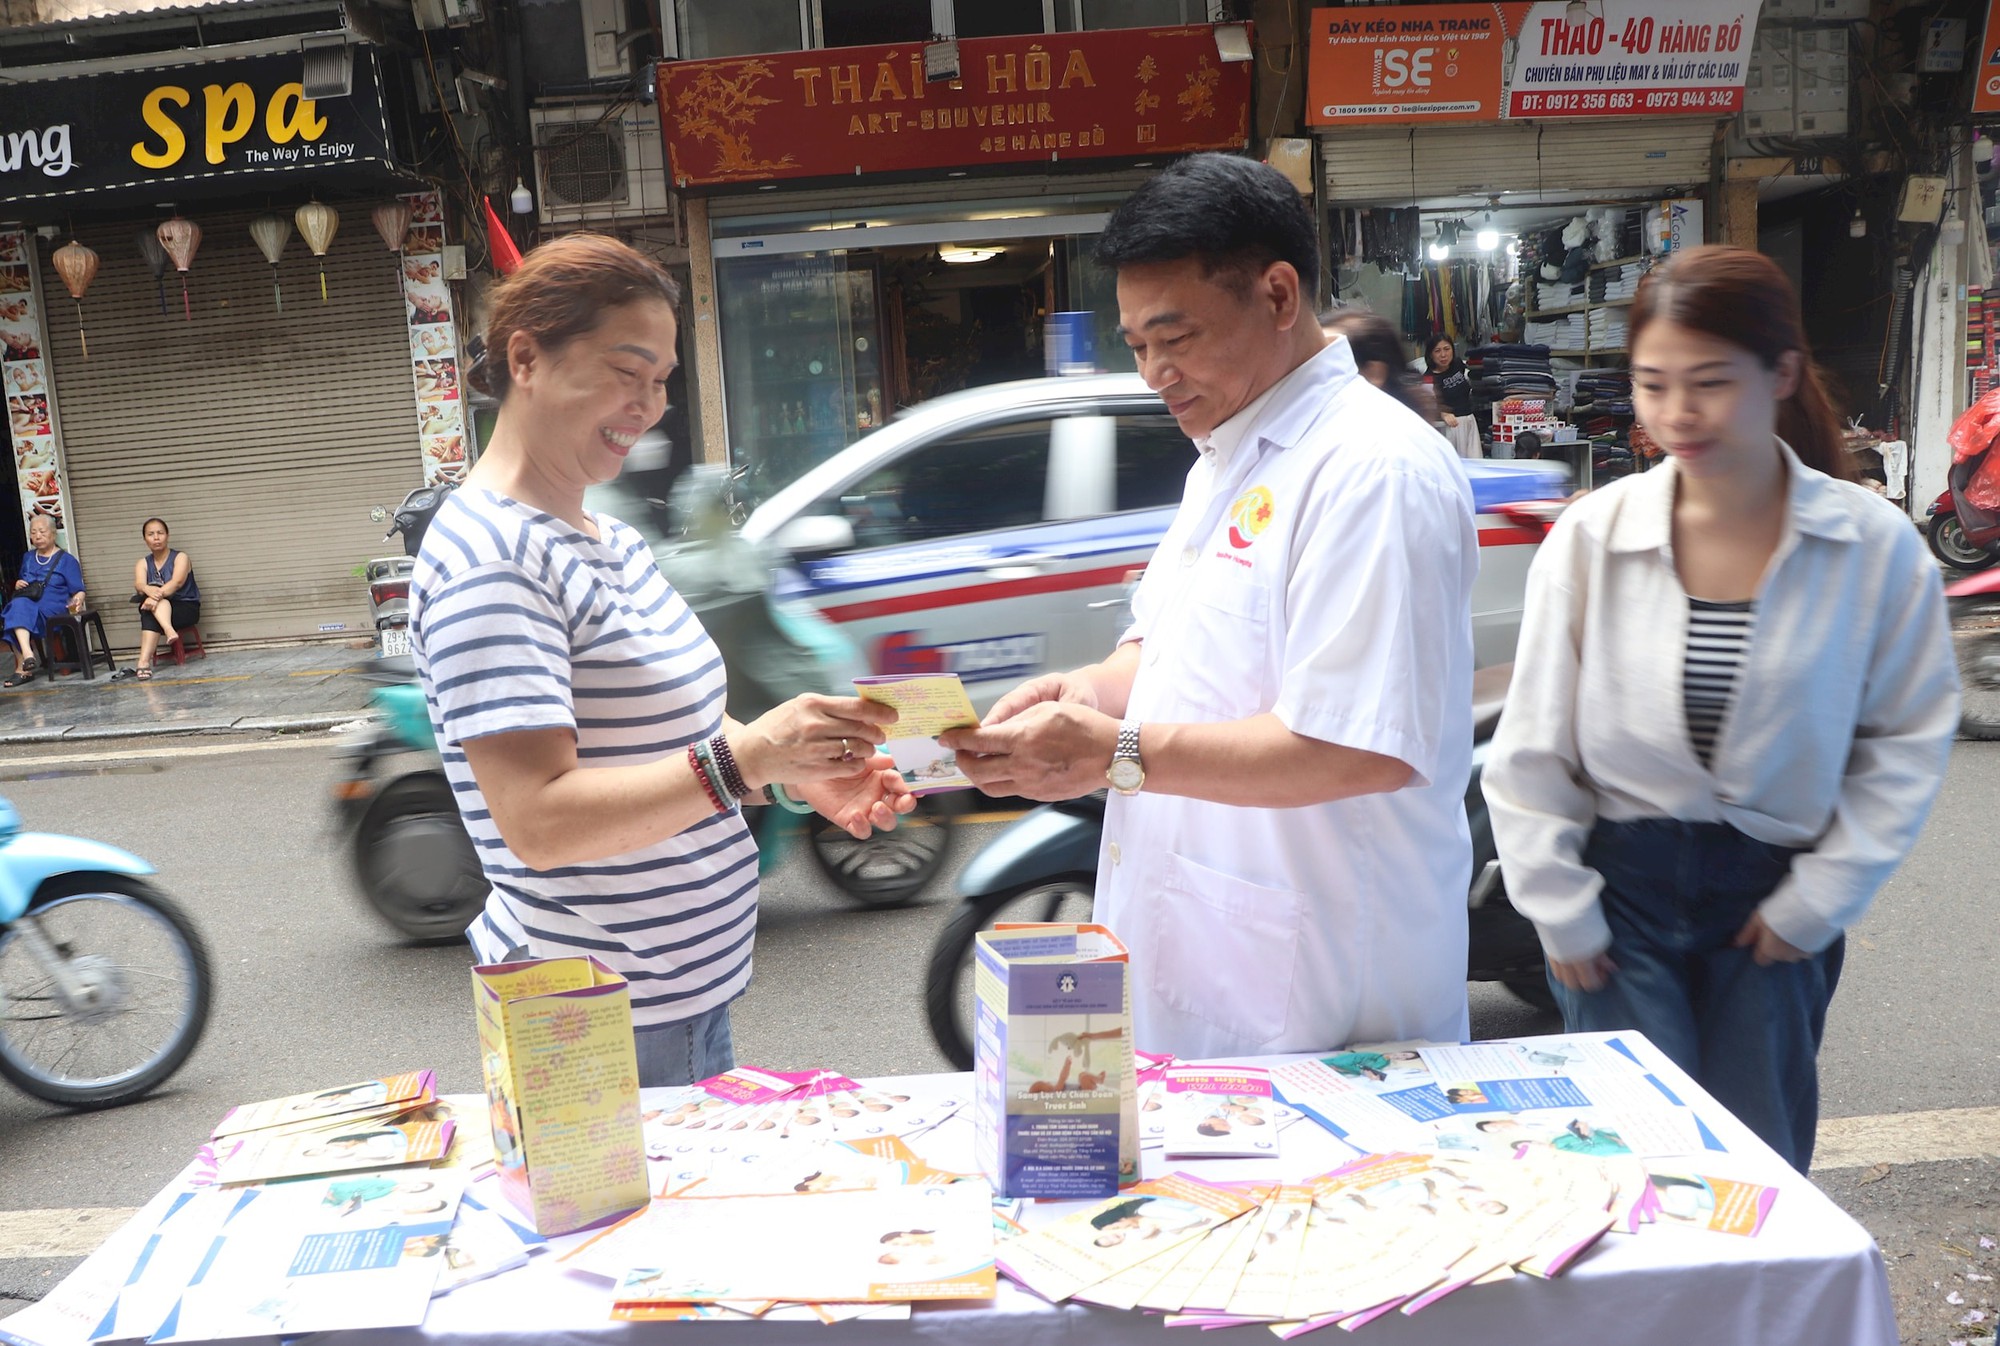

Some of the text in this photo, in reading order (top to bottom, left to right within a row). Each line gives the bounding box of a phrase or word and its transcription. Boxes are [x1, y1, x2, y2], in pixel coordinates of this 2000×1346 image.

[1329, 18, 1490, 34] DÂY KÉO NHA TRANG
[1621, 16, 1654, 54] 40
[1659, 19, 1712, 54] HÀNG
[1359, 35, 1378, 43] khai
[1442, 32, 1458, 43] Việt
[1471, 32, 1491, 40] 1987
[986, 44, 1096, 93] HÒA
[1525, 58, 1739, 84] CHUYÊN BÁN PHỤ LIỆU MAY & VẢI LÓT CÁC LOẠI
[1522, 94, 1542, 110] ĐT:
[1546, 94, 1579, 110] 0912
[1581, 93, 1606, 109] 356
[1609, 93, 1634, 108] 663
[1646, 92, 1679, 107] 0973
[1681, 91, 1705, 106] 944
[1709, 91, 1733, 106] 342
[980, 136, 1006, 152] 42
[1012, 129, 1071, 150] HÀNG
[245, 142, 355, 163] The Way To Enjoy
[1800, 156, 1818, 171] 40
